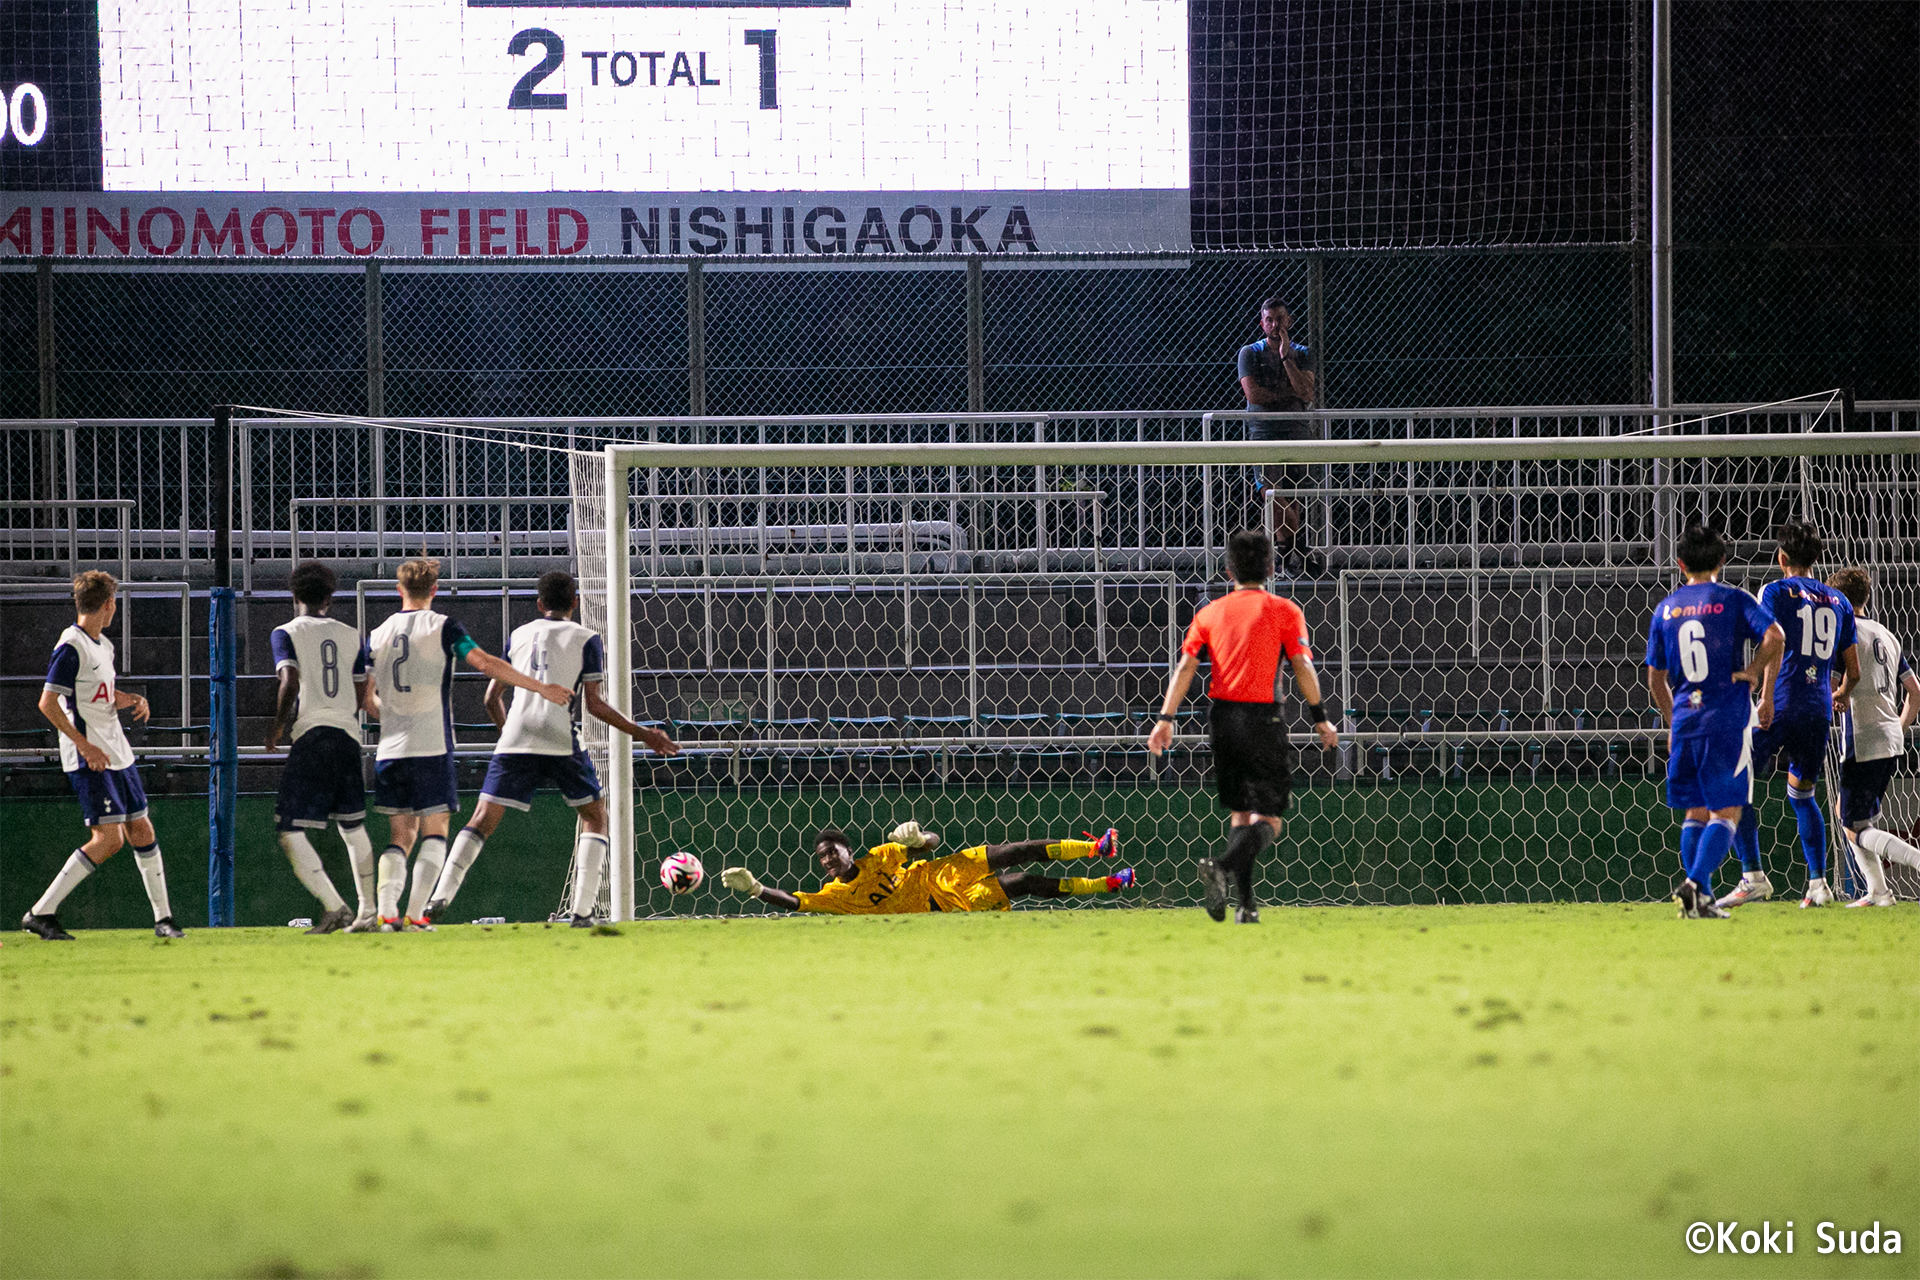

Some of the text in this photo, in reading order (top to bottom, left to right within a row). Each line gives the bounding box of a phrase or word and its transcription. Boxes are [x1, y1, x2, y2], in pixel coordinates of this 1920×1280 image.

[507, 27, 779, 110] 2 TOTAL 1
[0, 82, 48, 147] 0
[420, 207, 590, 256] FIELD
[620, 205, 1041, 255] NISHIGAOKA
[530, 631, 549, 682] 4
[1677, 619, 1710, 684] 6
[1796, 604, 1838, 661] 19
[320, 638, 339, 699] 8
[392, 633, 412, 693] 2
[1872, 637, 1890, 695] 9
